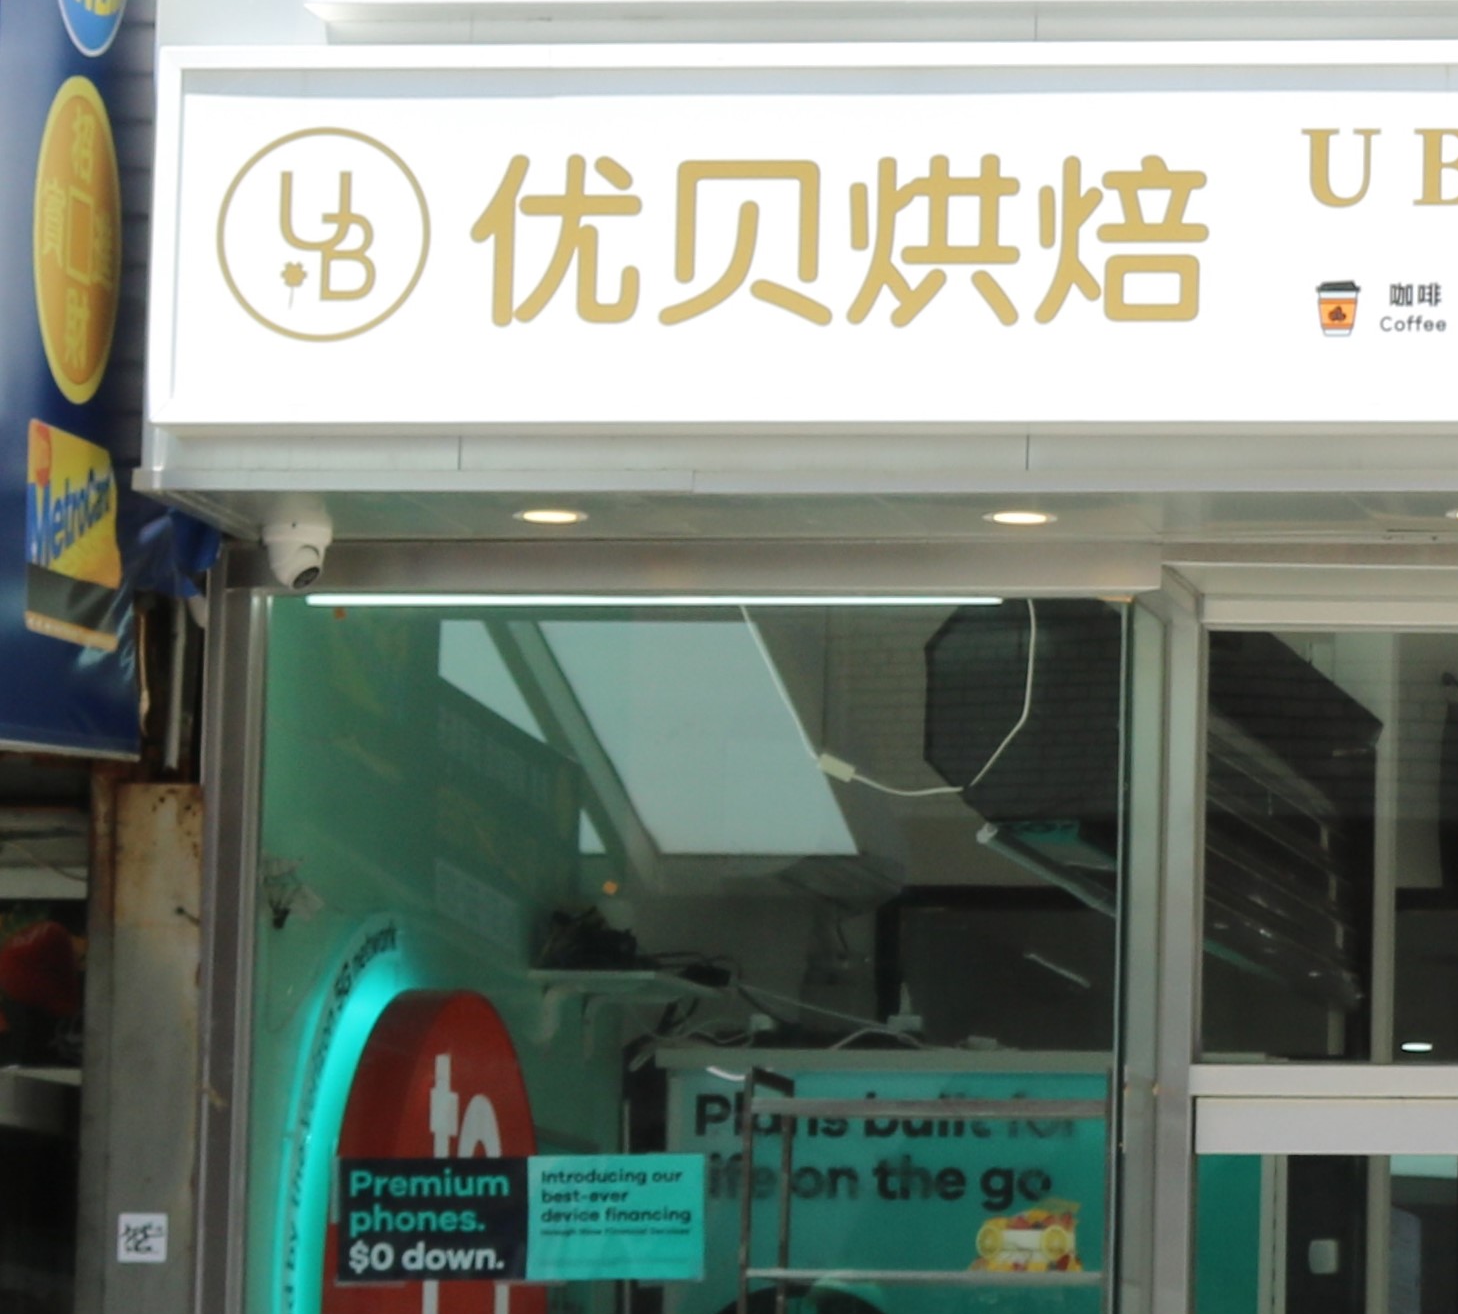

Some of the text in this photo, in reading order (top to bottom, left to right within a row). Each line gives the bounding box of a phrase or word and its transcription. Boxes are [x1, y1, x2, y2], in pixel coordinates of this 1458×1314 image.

[1301, 127, 1382, 208] U
[471, 153, 1210, 328] 优贝烘焙
[1388, 281, 1442, 309] 咖啡
[1379, 314, 1448, 334] Coffee
[350, 1168, 510, 1198] Premium
[541, 1170, 683, 1187] Introducing our
[791, 1166, 858, 1200] on
[873, 1154, 967, 1200] the
[981, 1166, 1053, 1211] go
[541, 1189, 629, 1204] best-ever
[350, 1202, 485, 1238] phones.
[541, 1206, 692, 1224] device financing
[349, 1239, 505, 1275] $0 down.
